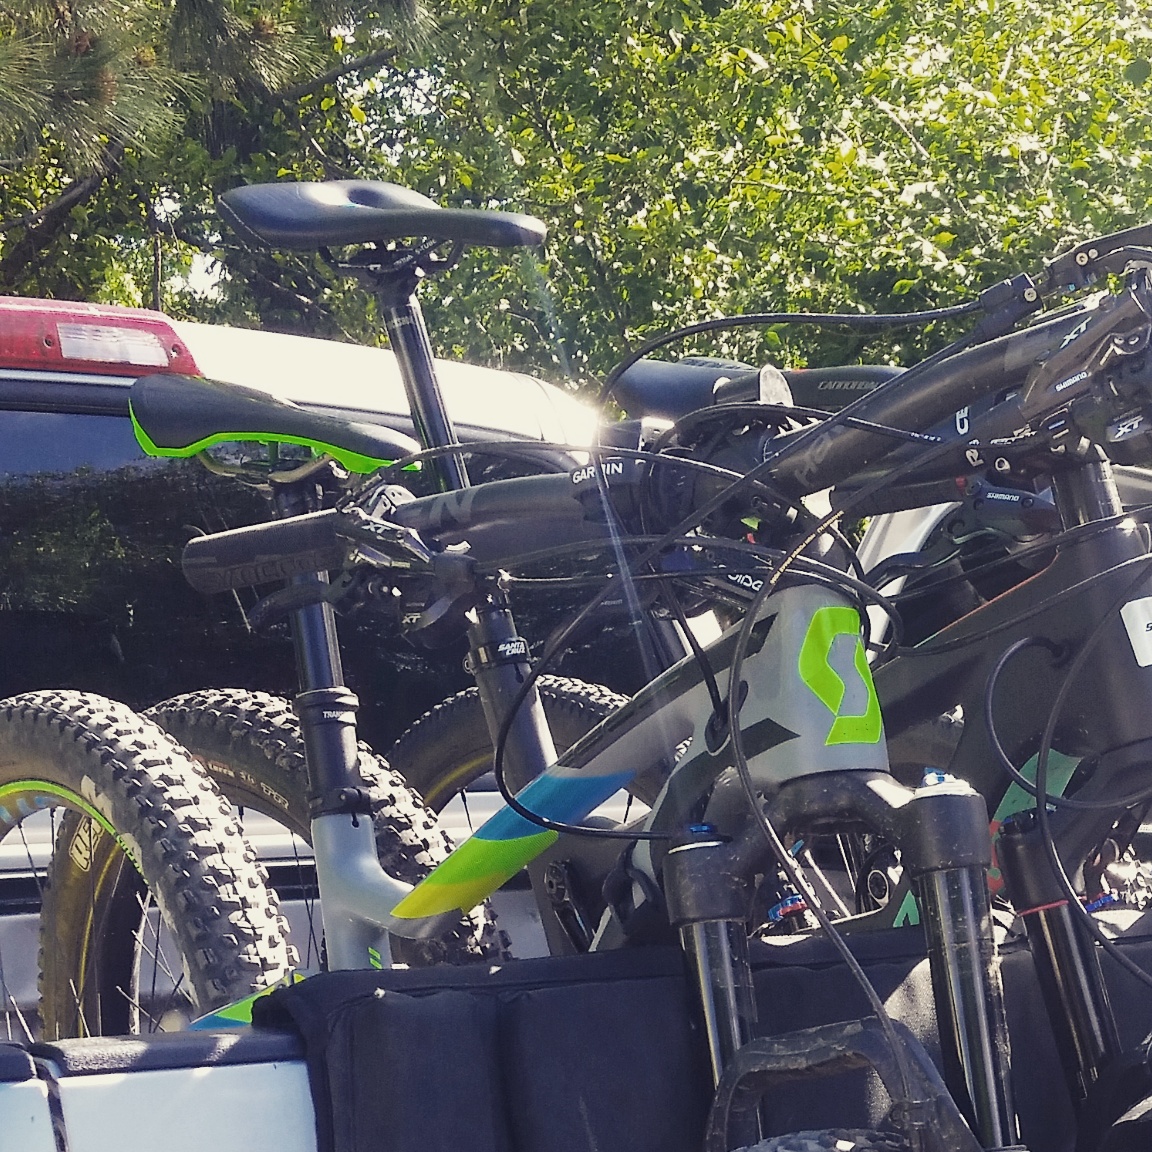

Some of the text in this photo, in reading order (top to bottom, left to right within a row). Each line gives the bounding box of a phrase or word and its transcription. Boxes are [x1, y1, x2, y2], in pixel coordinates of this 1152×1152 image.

[1060, 316, 1092, 349] XT
[1055, 371, 1089, 393] SHIMANO
[361, 521, 392, 535] XT
[498, 641, 525, 652] SANTA
[505, 647, 526, 656] CRUZ
